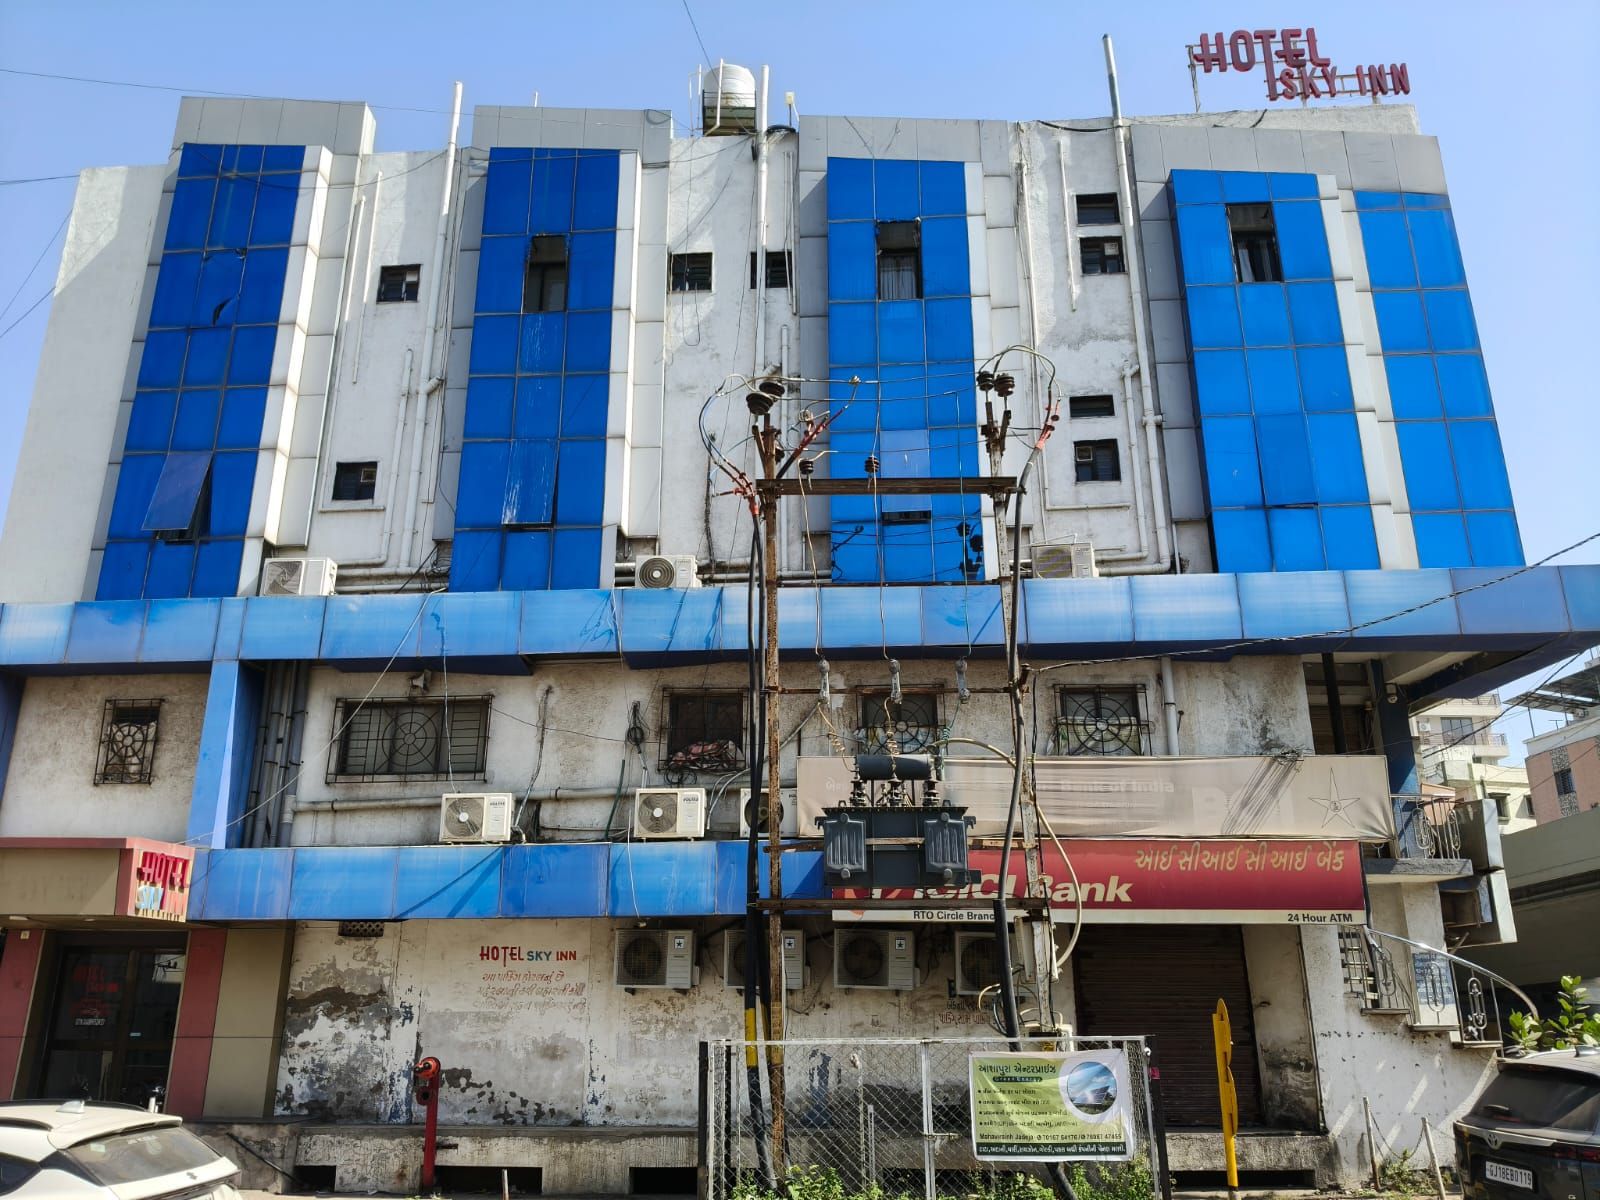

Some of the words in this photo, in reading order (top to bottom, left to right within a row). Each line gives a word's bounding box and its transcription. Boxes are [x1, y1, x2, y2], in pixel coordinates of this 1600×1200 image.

[1193, 28, 1331, 100] HOTEL
[1280, 66, 1337, 99] SKY
[1356, 63, 1411, 95] INN
[138, 852, 190, 909] HOTEL
[913, 911, 934, 920] RTO
[937, 911, 964, 920] Circle
[967, 911, 995, 920] Branc
[1287, 913, 1300, 922] 24
[1302, 913, 1328, 923] Hour
[1330, 913, 1353, 923] ATM
[479, 946, 524, 967] HOTEL
[527, 951, 552, 961] SKY
[556, 951, 577, 961] INN
